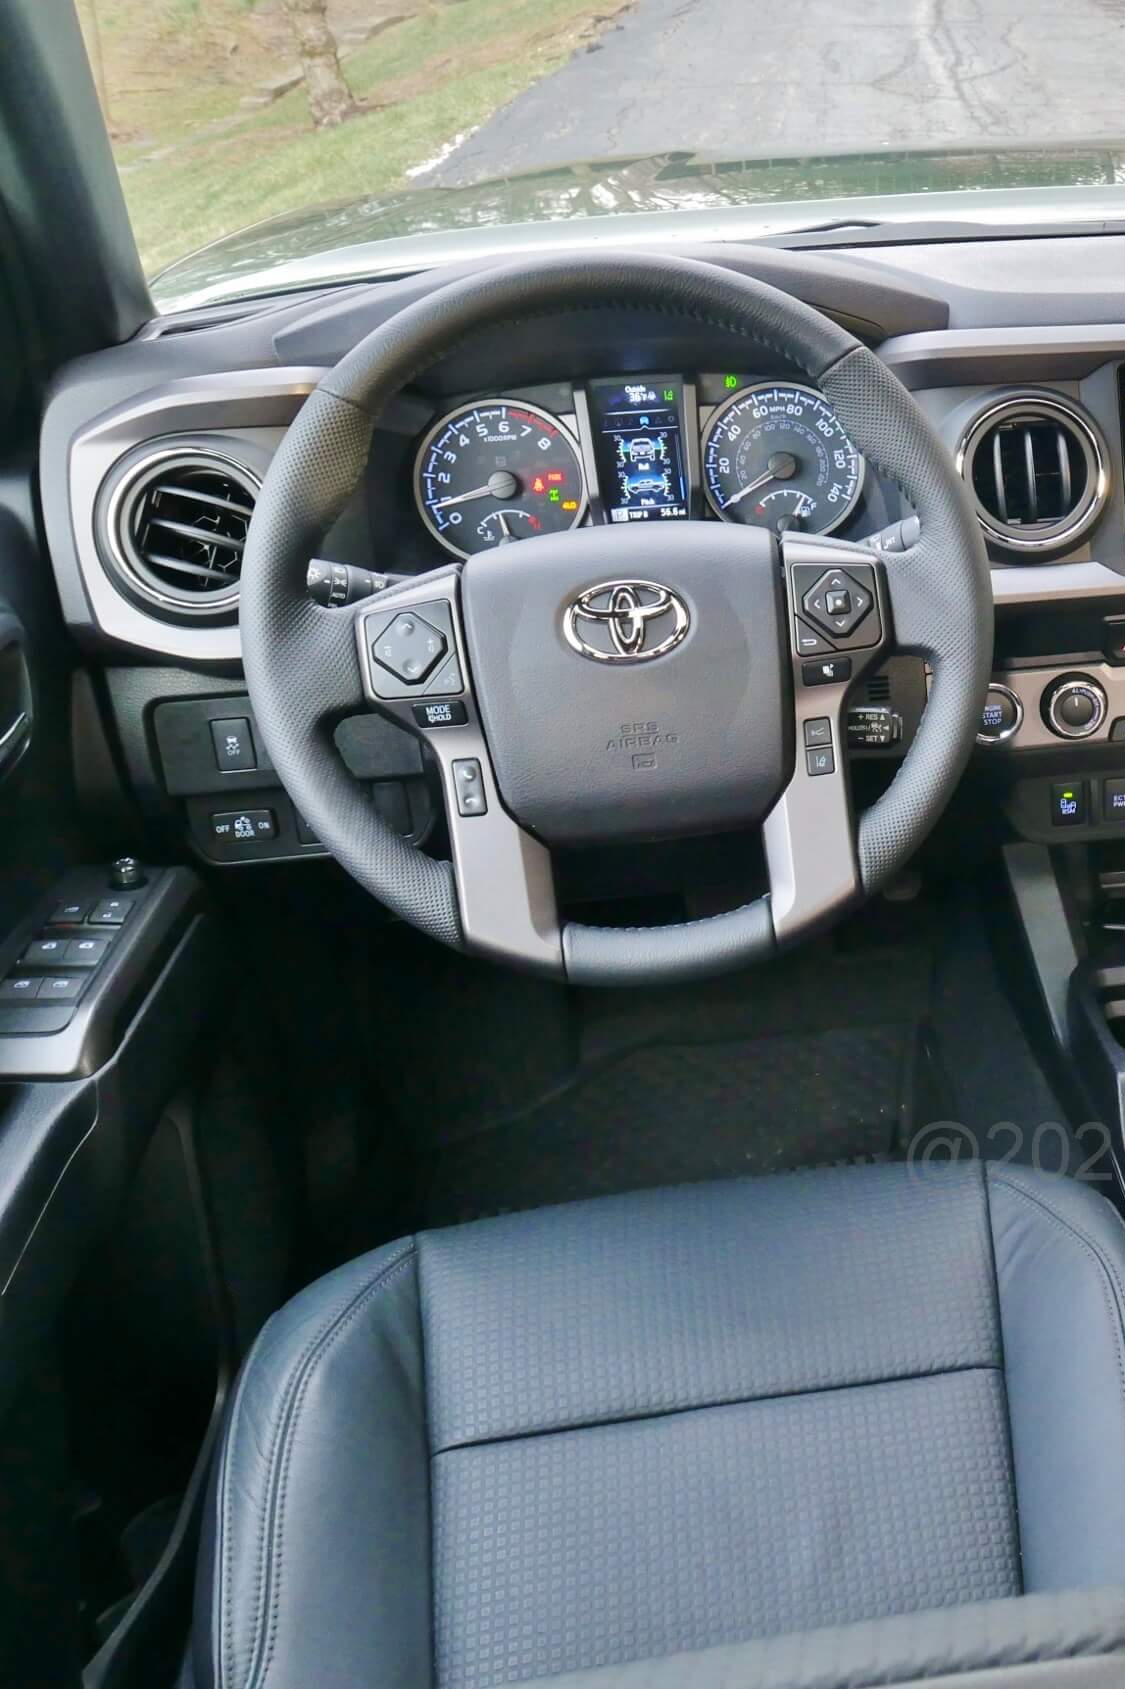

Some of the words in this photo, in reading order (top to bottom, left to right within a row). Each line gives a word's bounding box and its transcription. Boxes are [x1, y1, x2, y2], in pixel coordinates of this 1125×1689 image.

[752, 405, 769, 419] 60
[786, 404, 803, 416] 80
[476, 424, 489, 437] 5
[499, 421, 510, 433] 6
[520, 425, 532, 437] 7
[727, 425, 742, 441] 40
[816, 419, 834, 438] 100
[459, 434, 470, 447] 4
[537, 437, 551, 450] 8
[444, 450, 457, 463] 3
[834, 449, 846, 469] 120
[719, 457, 730, 474] 20
[438, 473, 450, 484] 2
[827, 482, 842, 502] 140
[450, 512, 462, 525] 0
[660, 507, 678, 517] 56.6
[425, 704, 451, 715] MODE
[620, 721, 659, 734] SRS
[983, 718, 1002, 726] STOP
[606, 735, 680, 750] AIRBAG
[227, 749, 240, 757] OFF
[216, 824, 230, 834] OFF
[235, 830, 255, 839] DOOR
